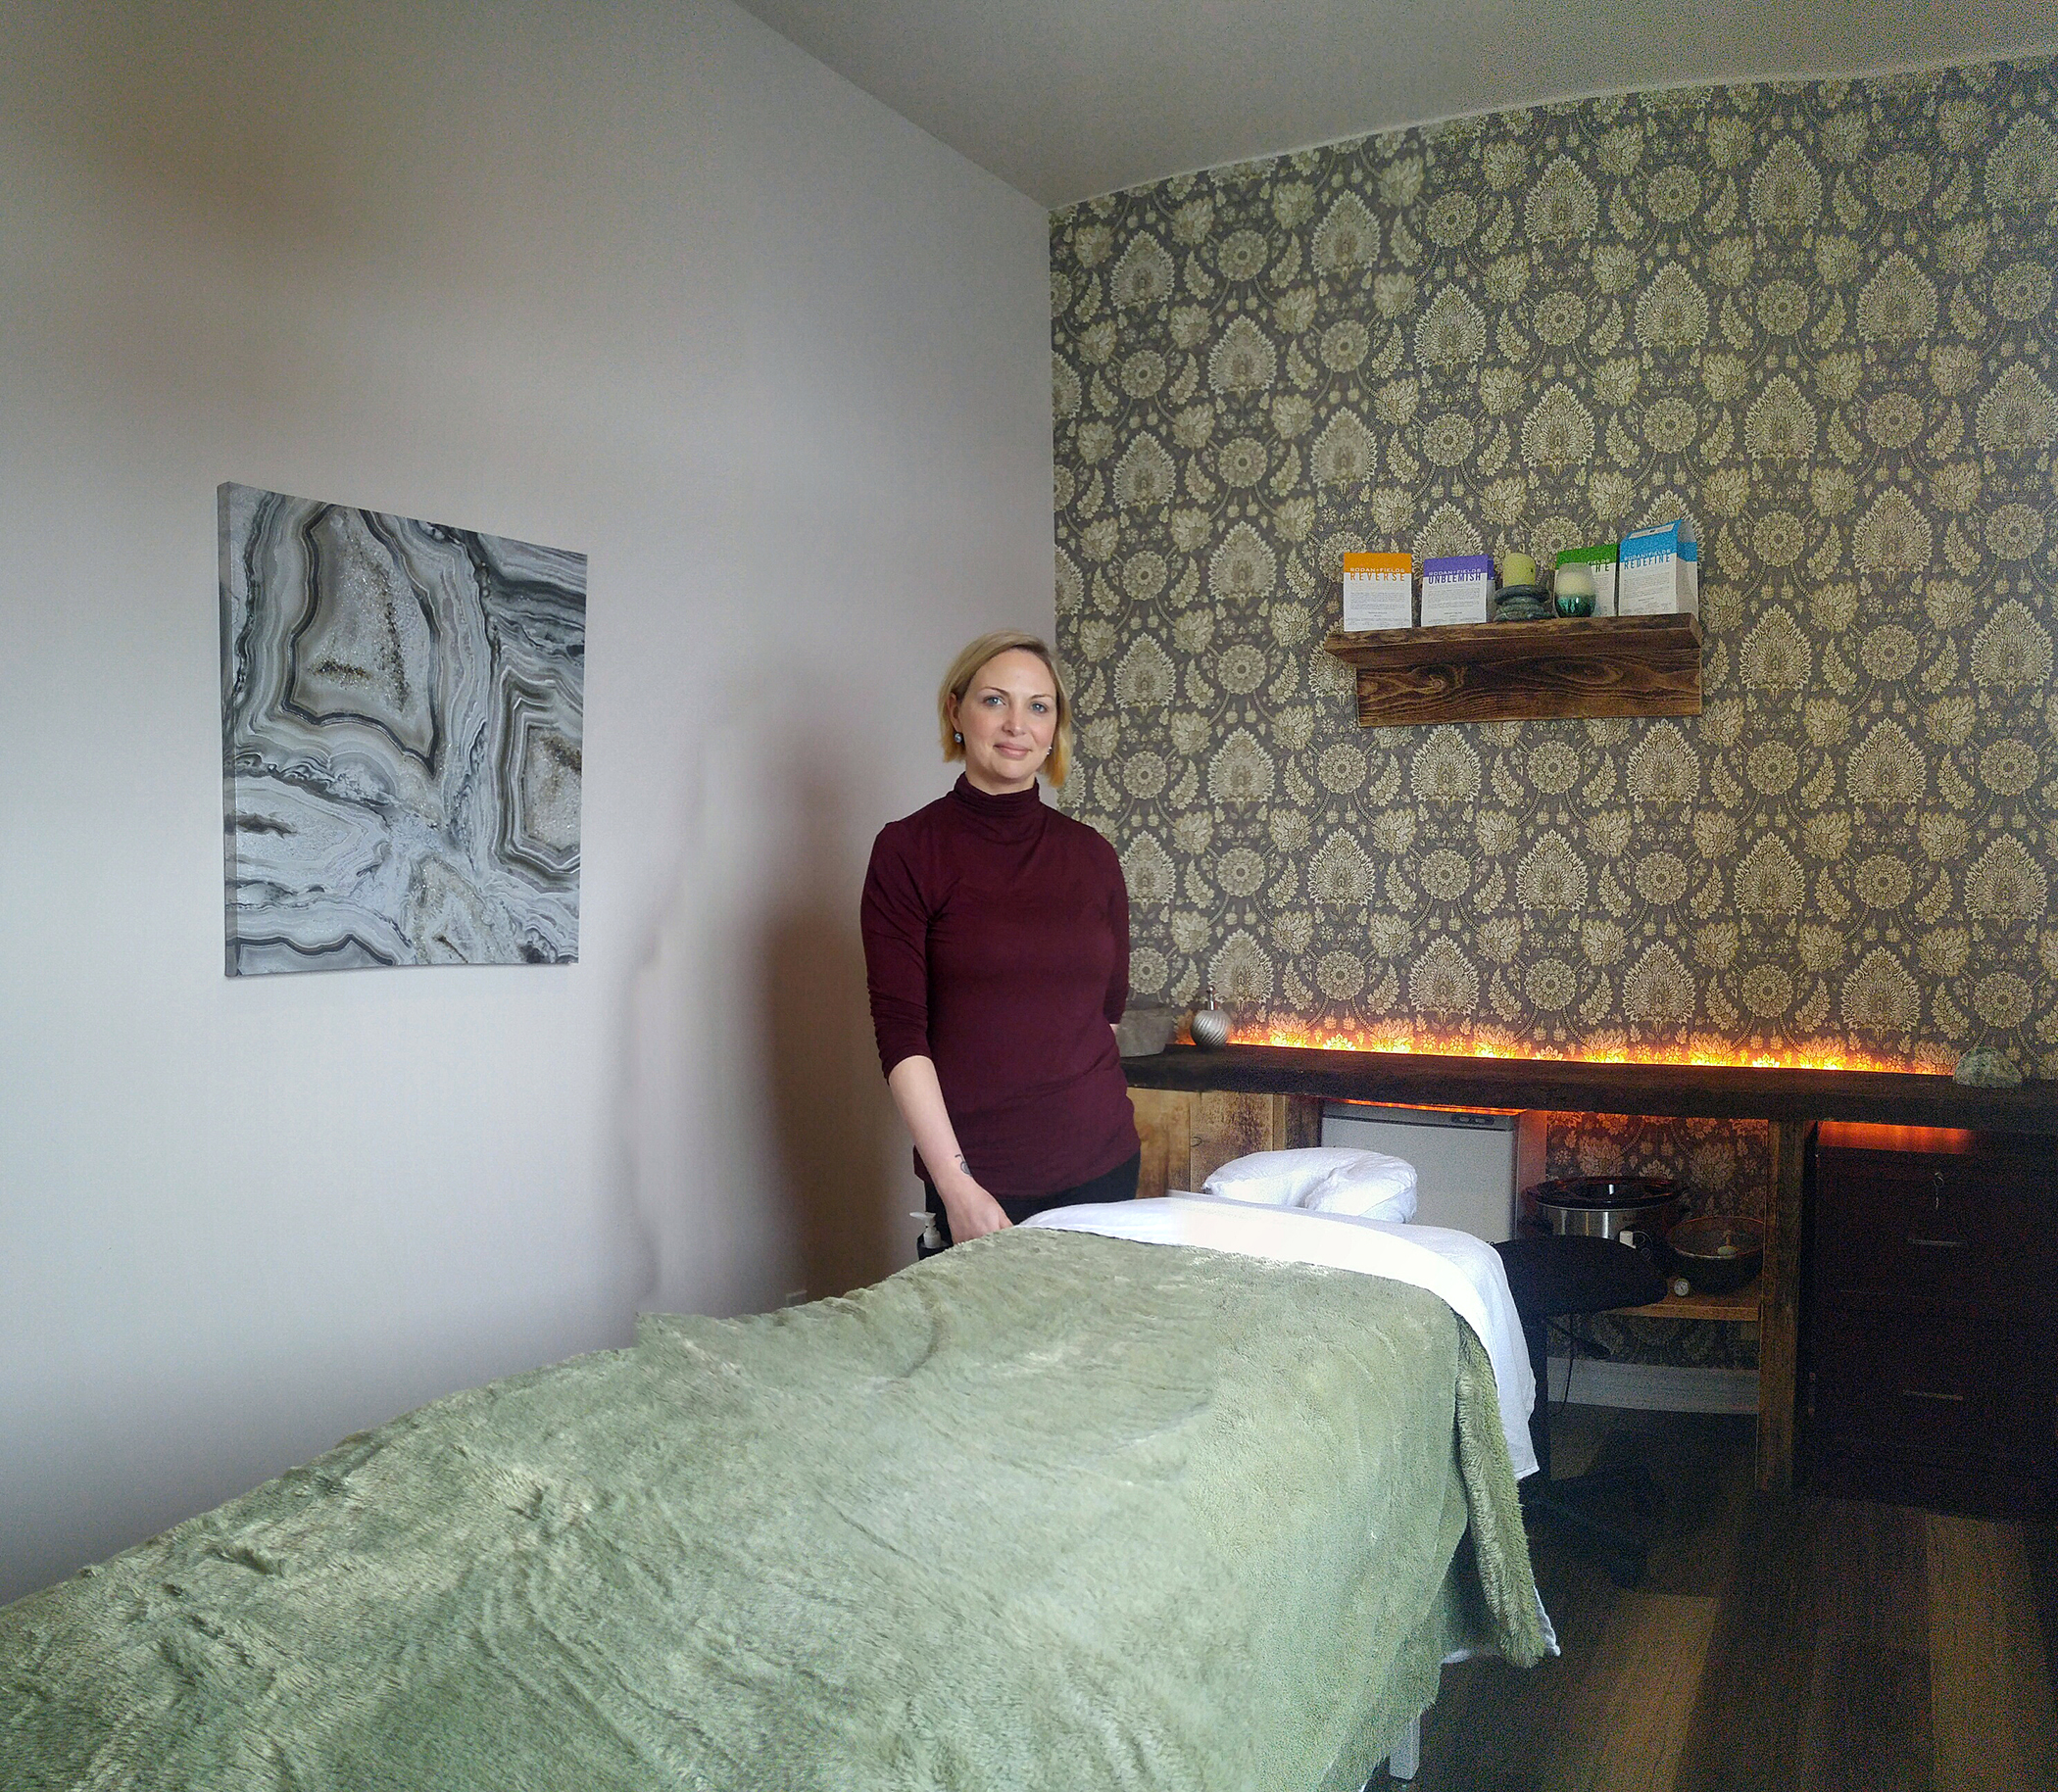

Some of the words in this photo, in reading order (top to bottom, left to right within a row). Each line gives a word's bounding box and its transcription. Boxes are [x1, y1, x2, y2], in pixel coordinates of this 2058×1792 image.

[1624, 554, 1671, 570] REDEFINE
[1349, 572, 1405, 582] REVERSE
[1428, 572, 1481, 585] UNBLEMISH
